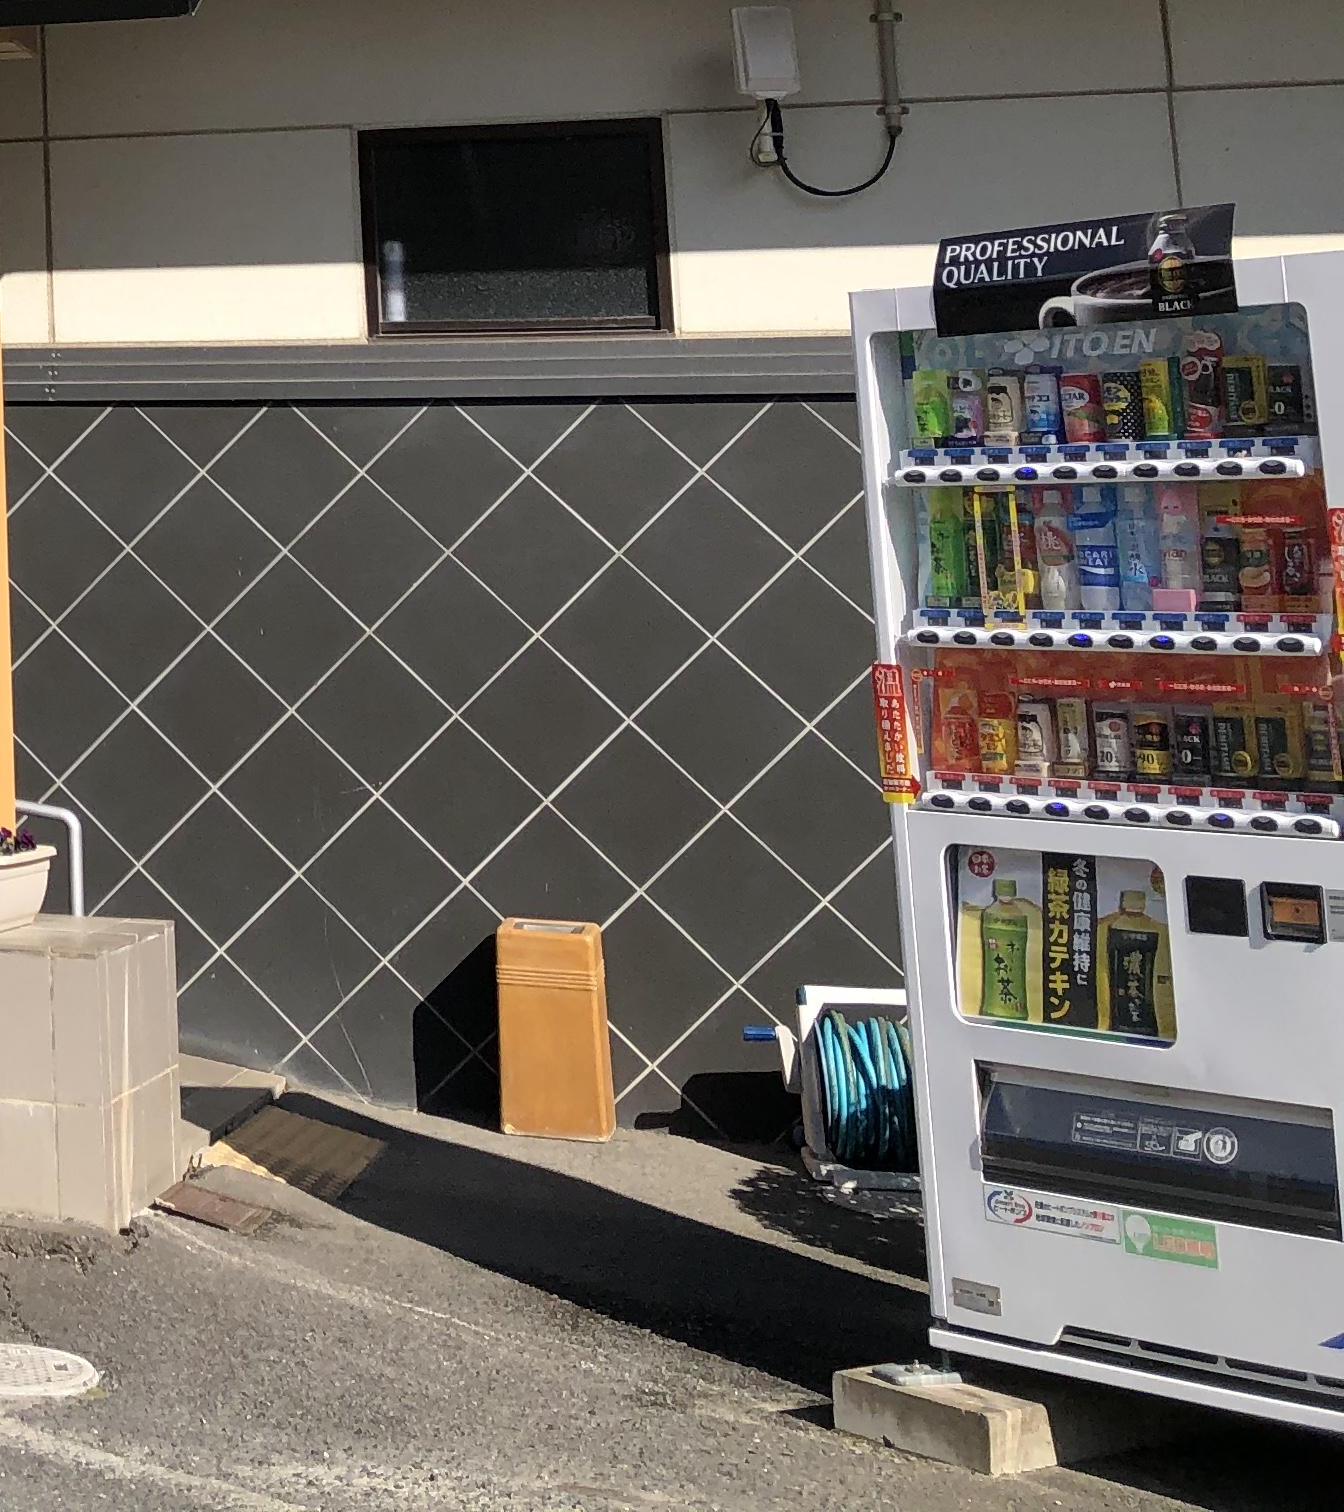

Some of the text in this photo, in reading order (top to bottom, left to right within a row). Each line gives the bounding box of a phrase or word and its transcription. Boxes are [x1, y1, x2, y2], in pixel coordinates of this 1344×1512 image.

[942, 256, 1049, 288] QUALITY
[944, 226, 1125, 264] PROFESSIONAL
[1047, 867, 1071, 1020] 緑茶カテキン
[1072, 858, 1092, 986] 冬の健康維持に
